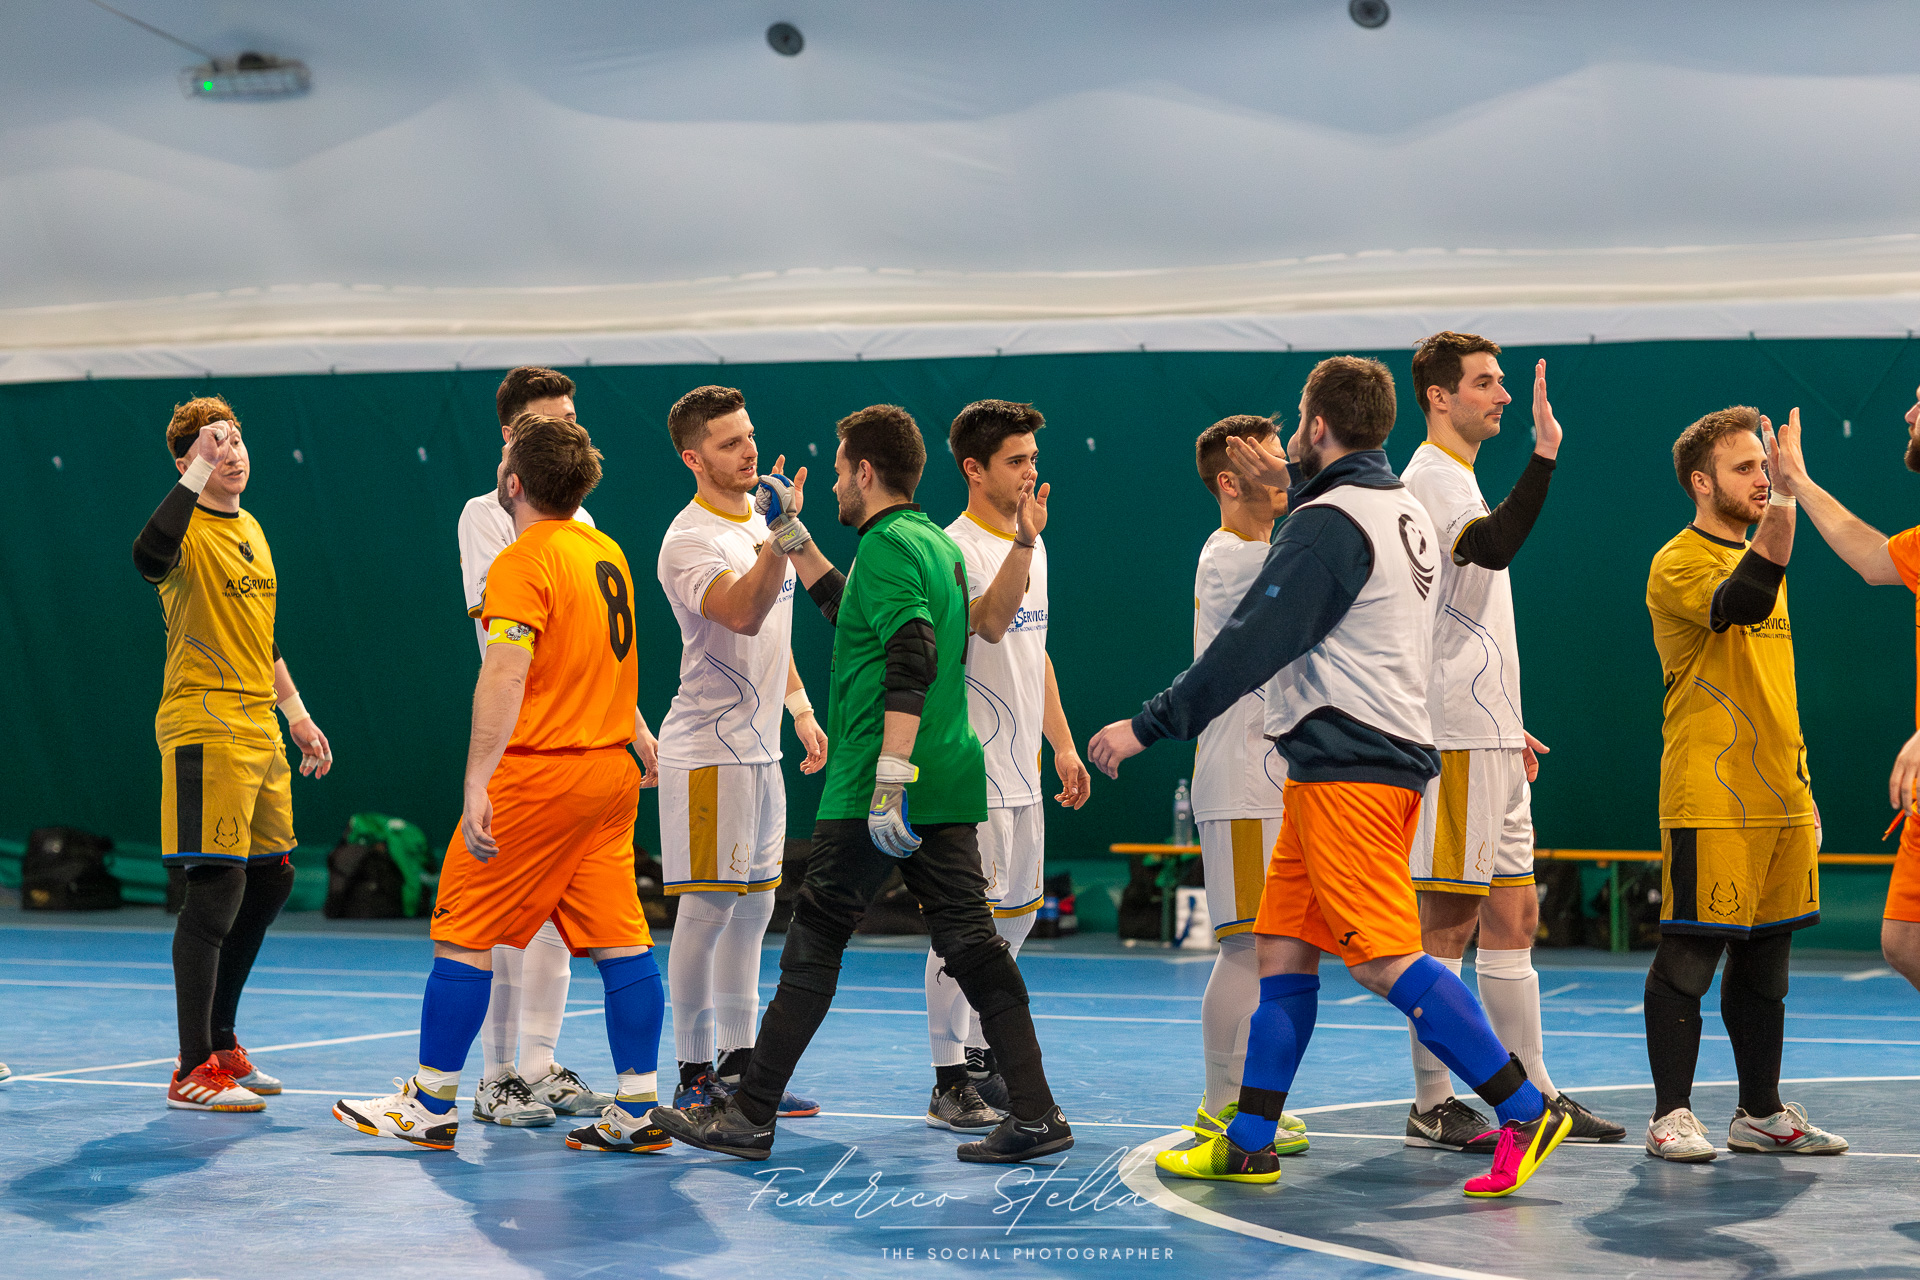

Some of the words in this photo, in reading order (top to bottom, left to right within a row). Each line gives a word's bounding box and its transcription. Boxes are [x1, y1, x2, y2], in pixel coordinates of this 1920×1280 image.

[595, 561, 633, 663] 8
[1807, 868, 1816, 903] 1
[647, 1129, 663, 1137] TOP
